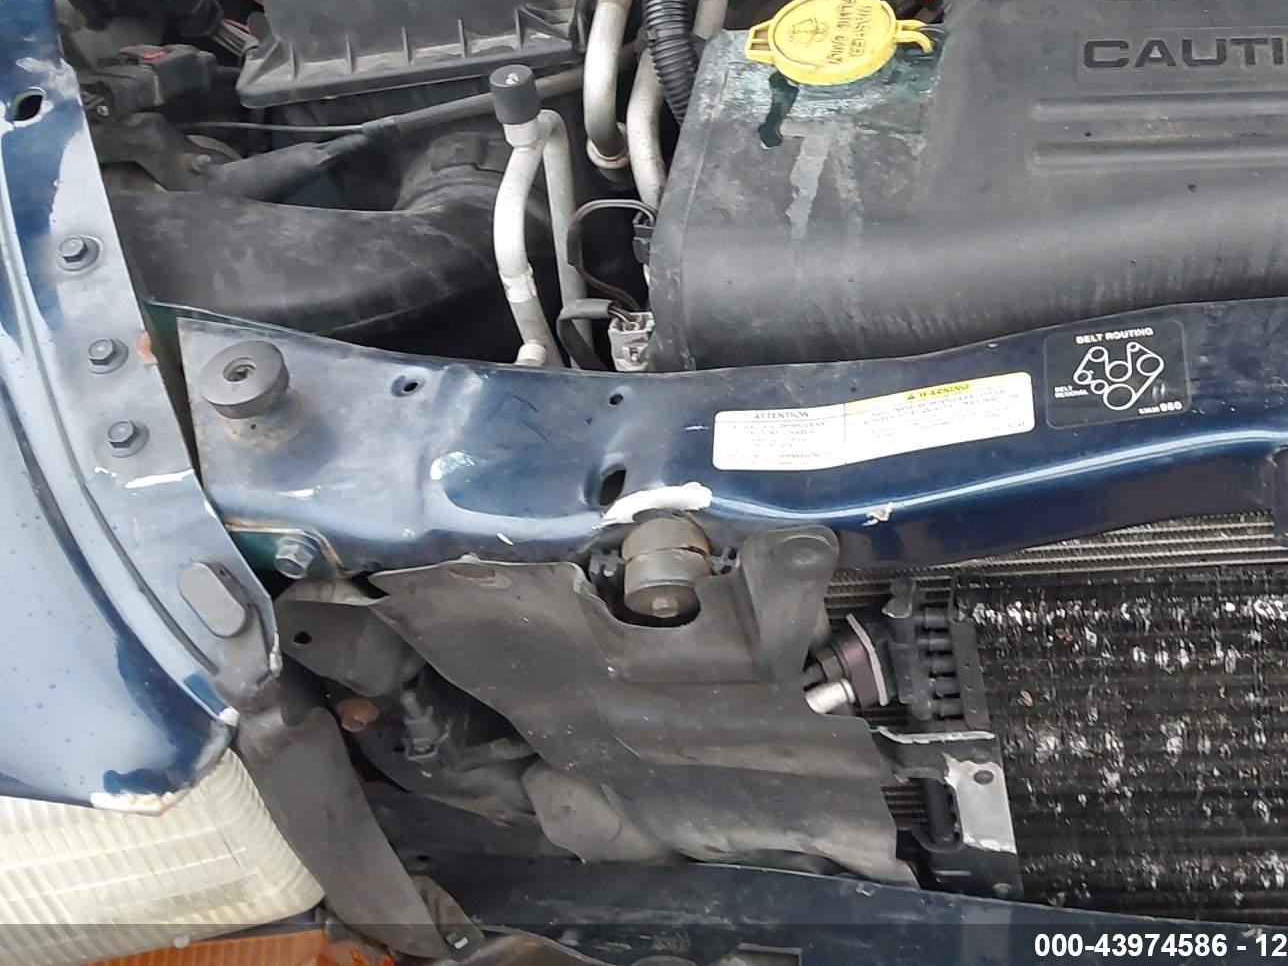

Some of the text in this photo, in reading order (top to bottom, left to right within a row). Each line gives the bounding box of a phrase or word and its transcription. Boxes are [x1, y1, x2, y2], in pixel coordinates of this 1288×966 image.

[1076, 327, 1154, 344] BELT ROUTING
[919, 384, 970, 399] WARNING
[753, 411, 810, 420] ATTENTION
